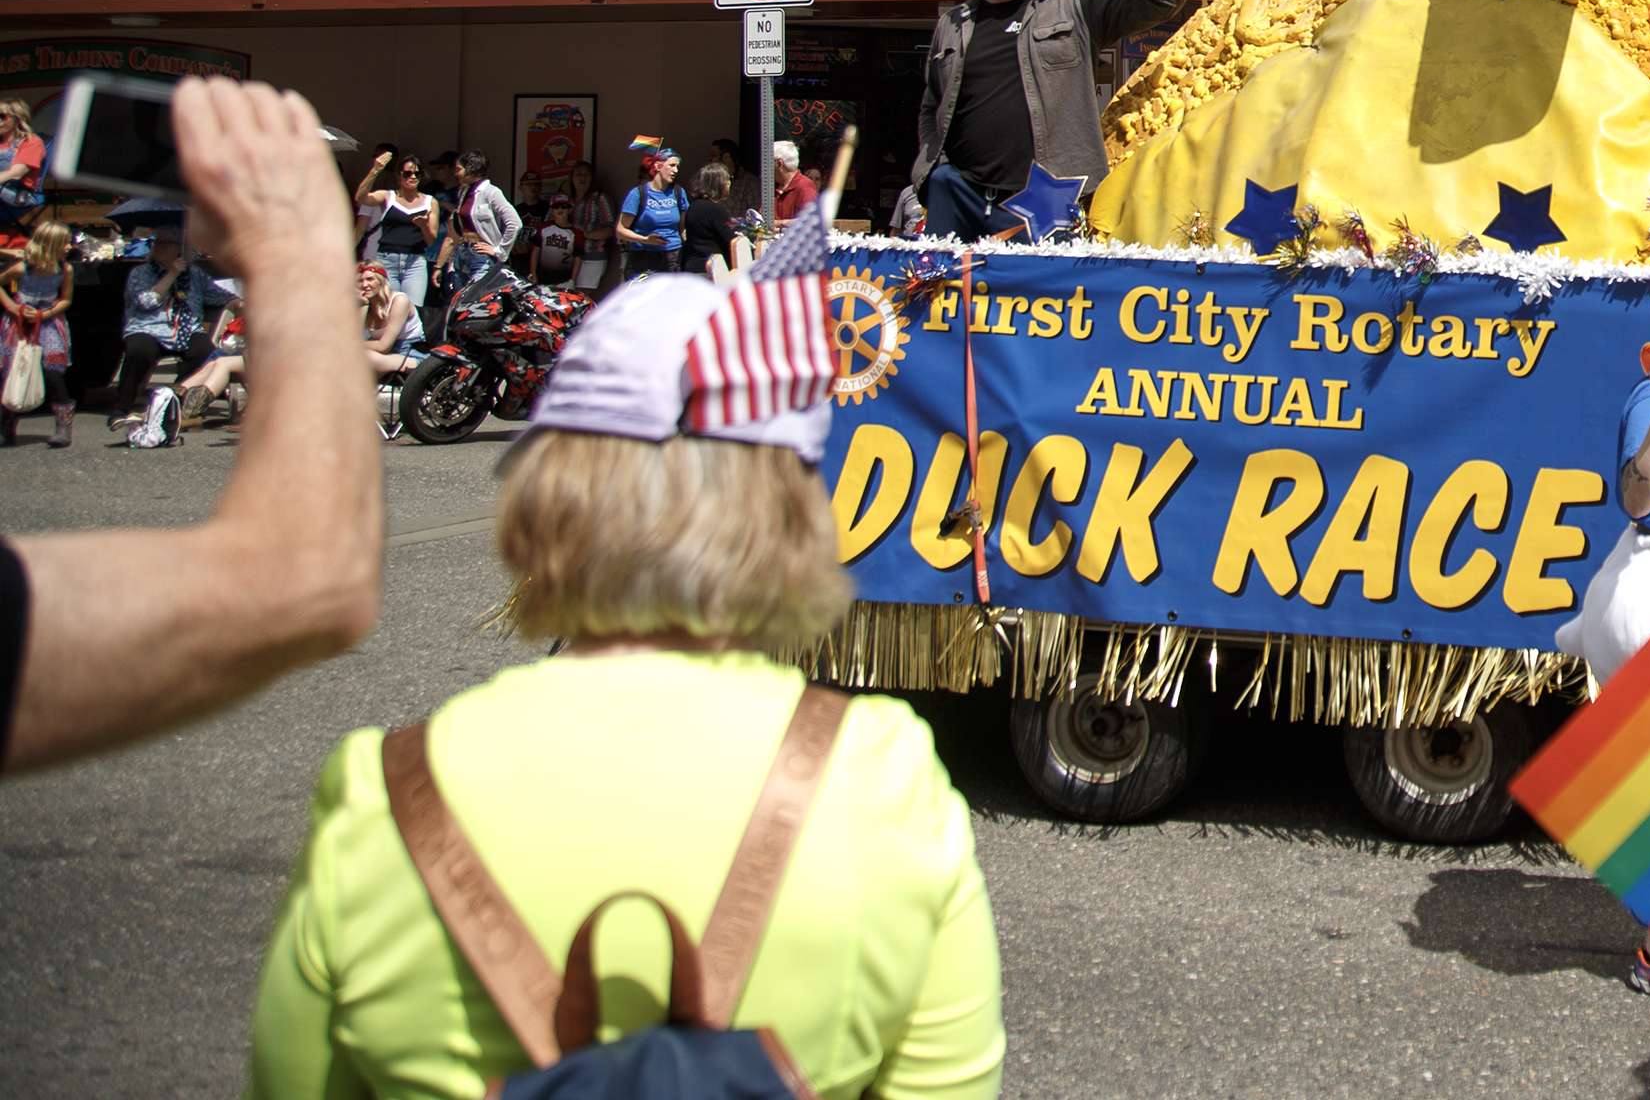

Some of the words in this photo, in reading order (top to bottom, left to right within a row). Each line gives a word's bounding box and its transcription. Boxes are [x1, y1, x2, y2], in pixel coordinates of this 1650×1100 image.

[757, 20, 772, 33] NO
[748, 56, 782, 65] CROSSING
[749, 40, 781, 49] PEDESTRIAN
[773, 98, 844, 131] TORE
[826, 280, 877, 297] ROTARY
[923, 280, 1093, 342] First
[1119, 285, 1270, 363] City
[1291, 293, 1556, 377] Rotary
[834, 359, 889, 391] NATIONAL
[1075, 367, 1363, 430] ANNUAL
[836, 422, 1194, 584] DUCK
[1212, 447, 1604, 615] RACE
